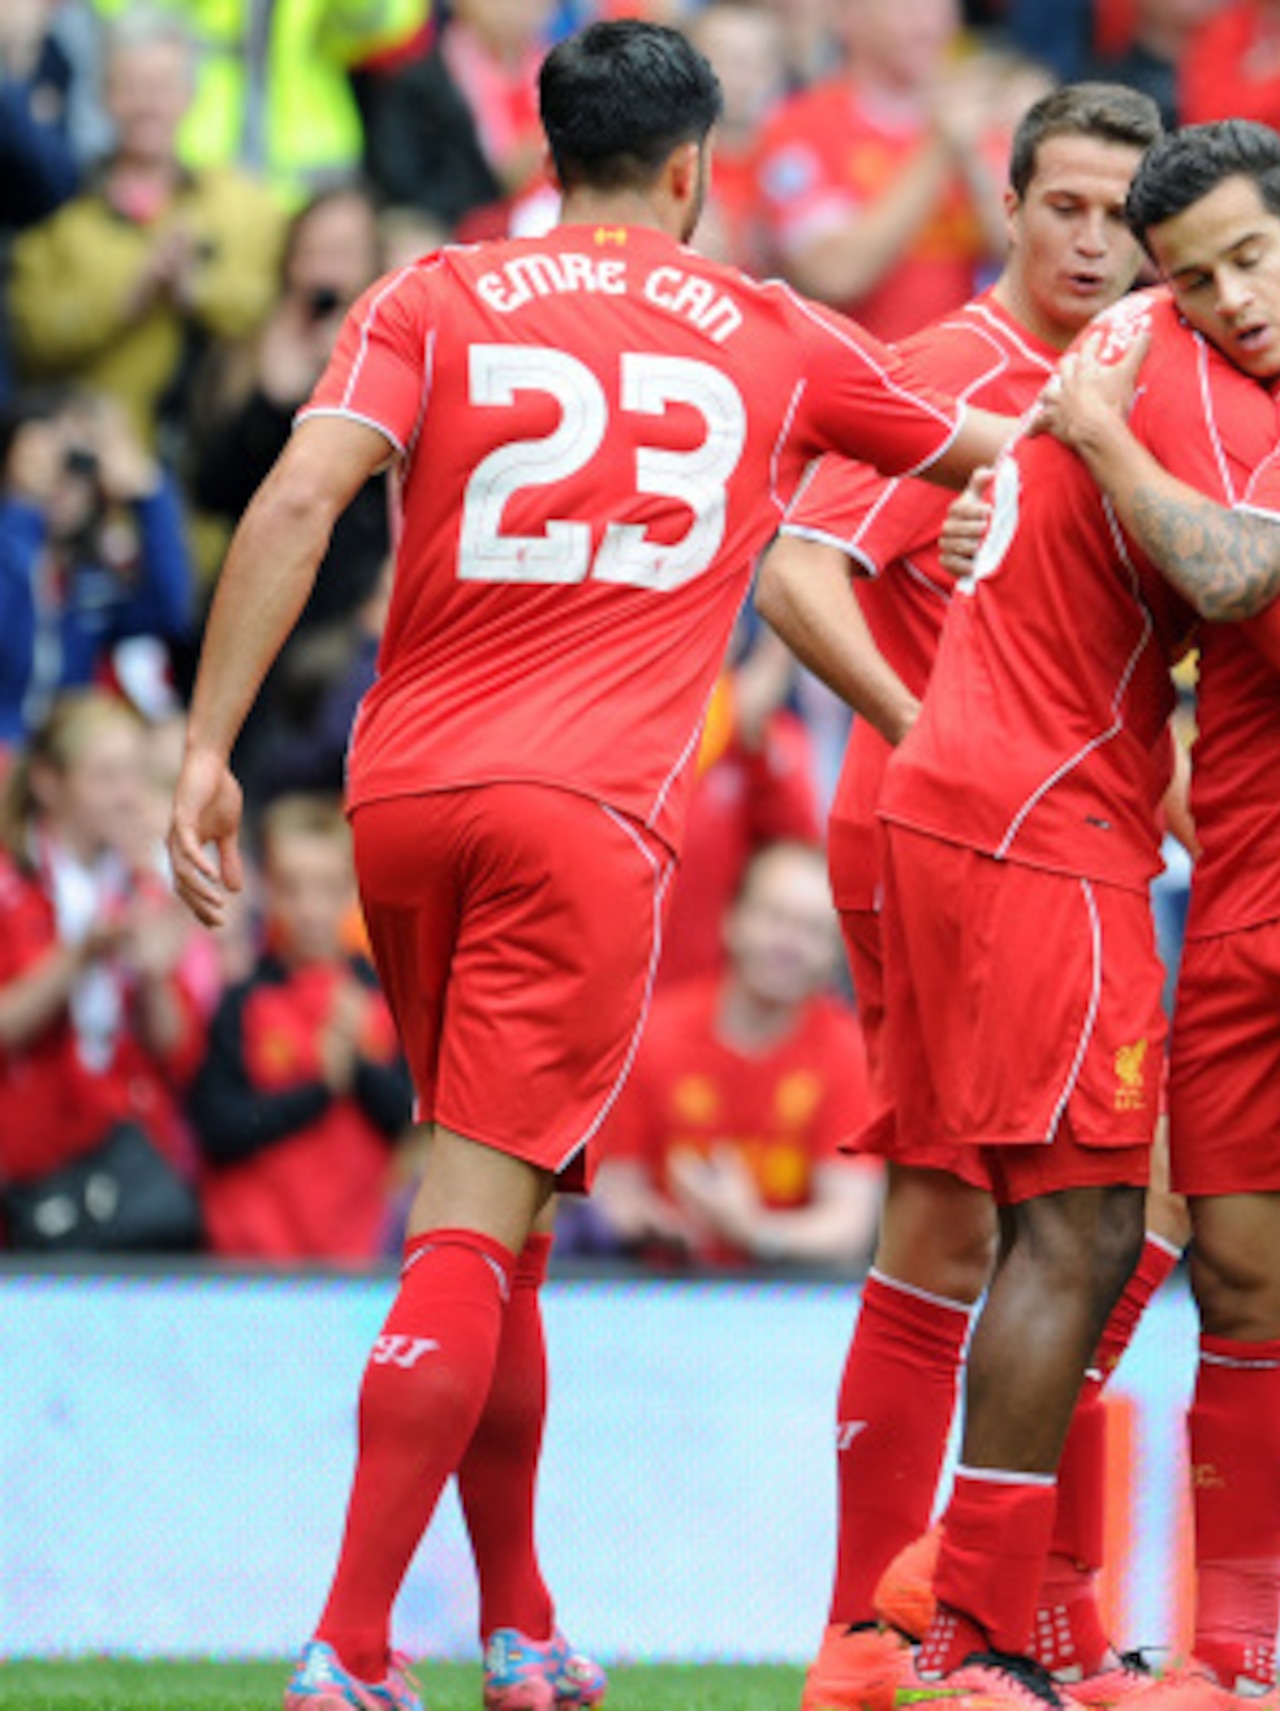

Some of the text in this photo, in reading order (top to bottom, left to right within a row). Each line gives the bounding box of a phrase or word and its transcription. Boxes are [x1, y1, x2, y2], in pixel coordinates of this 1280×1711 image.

[476, 252, 743, 343] EMRE CAN
[457, 342, 747, 592] 23
